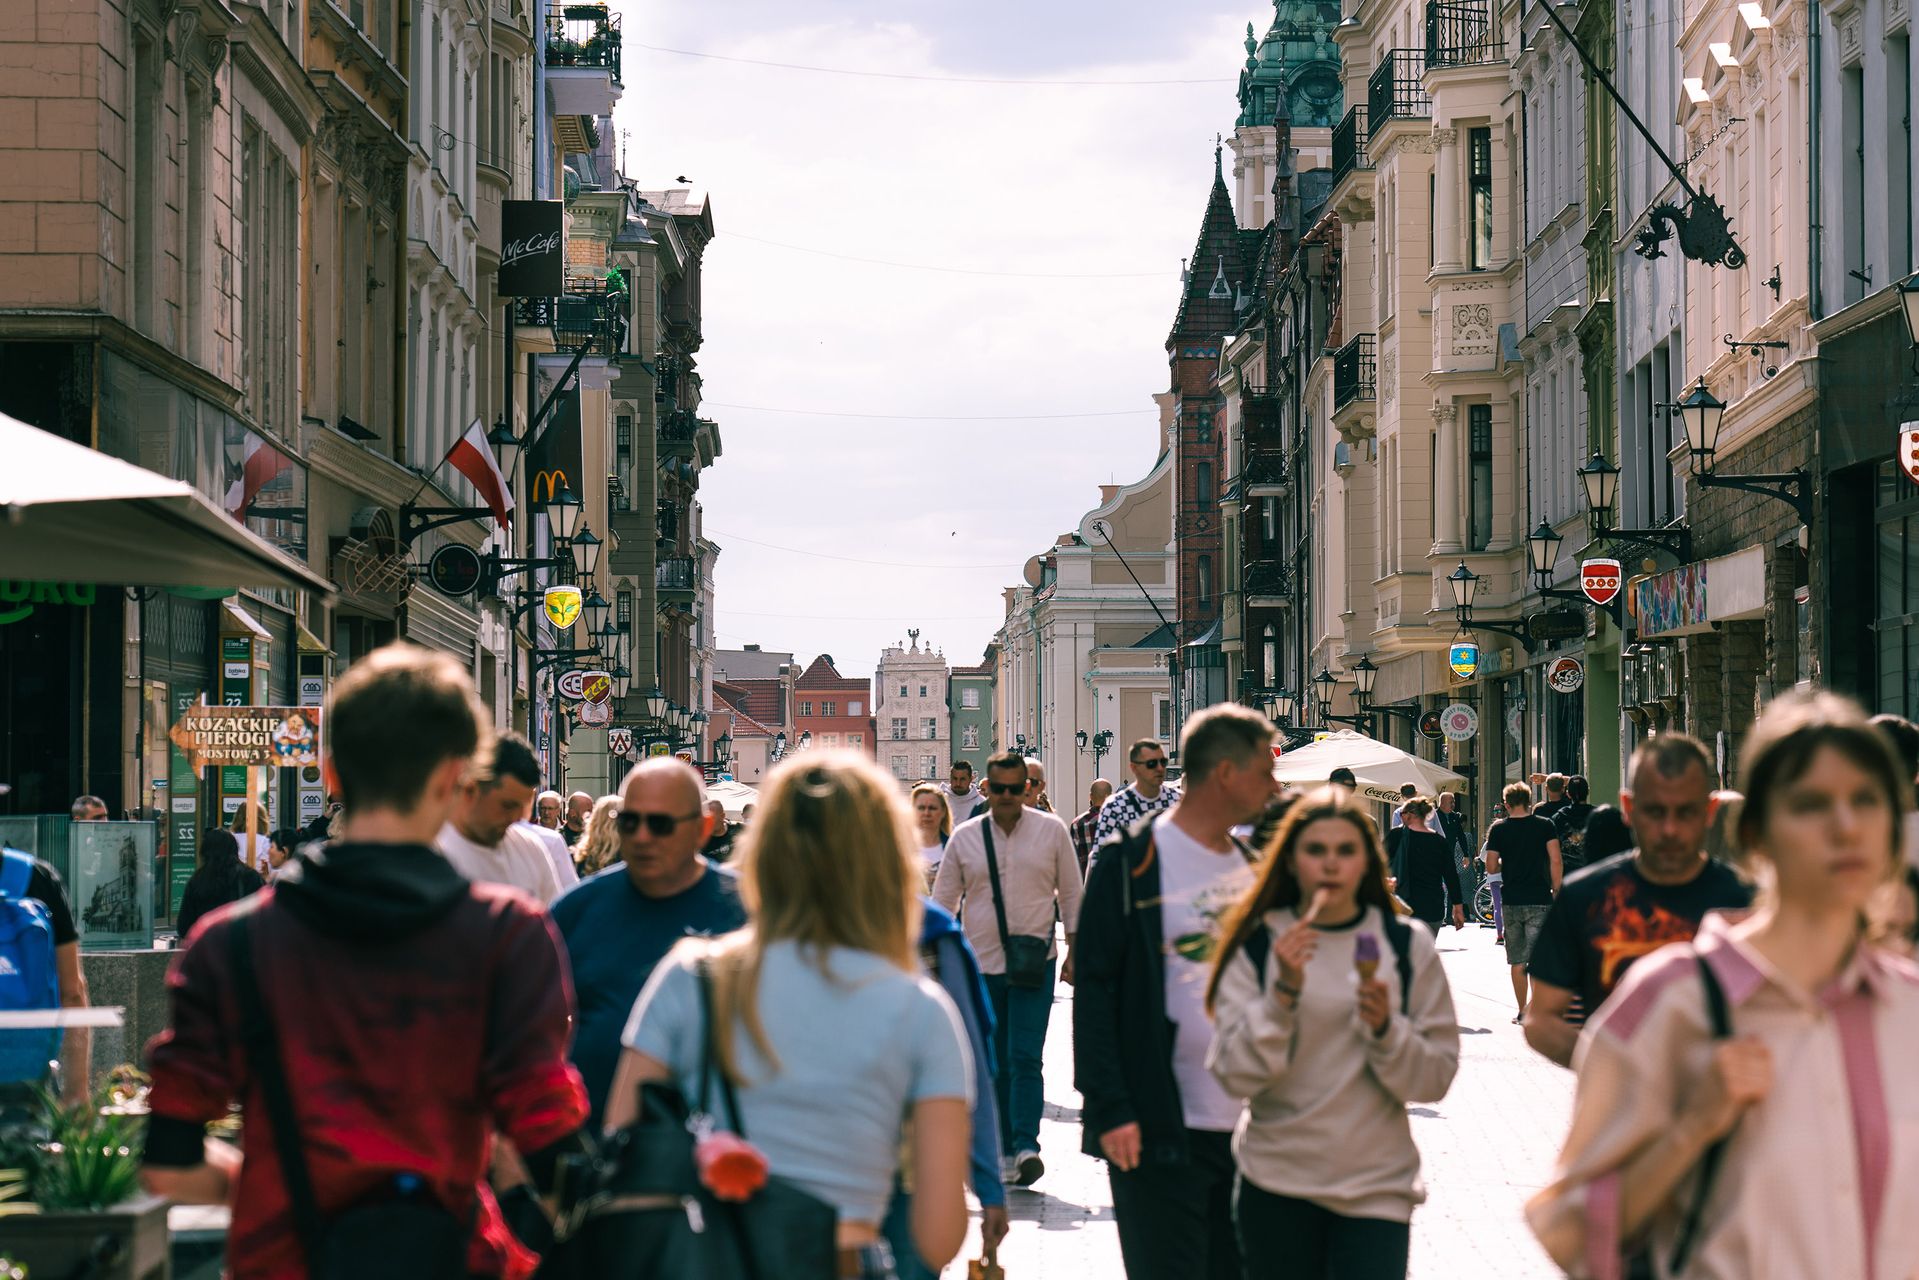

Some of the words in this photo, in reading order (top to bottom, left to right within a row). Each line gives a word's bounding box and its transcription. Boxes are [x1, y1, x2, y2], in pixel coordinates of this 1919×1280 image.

[186, 717, 280, 732] KOZACKIE
[195, 731, 271, 746] PIEROGI
[197, 749, 260, 759] MOSTOWA
